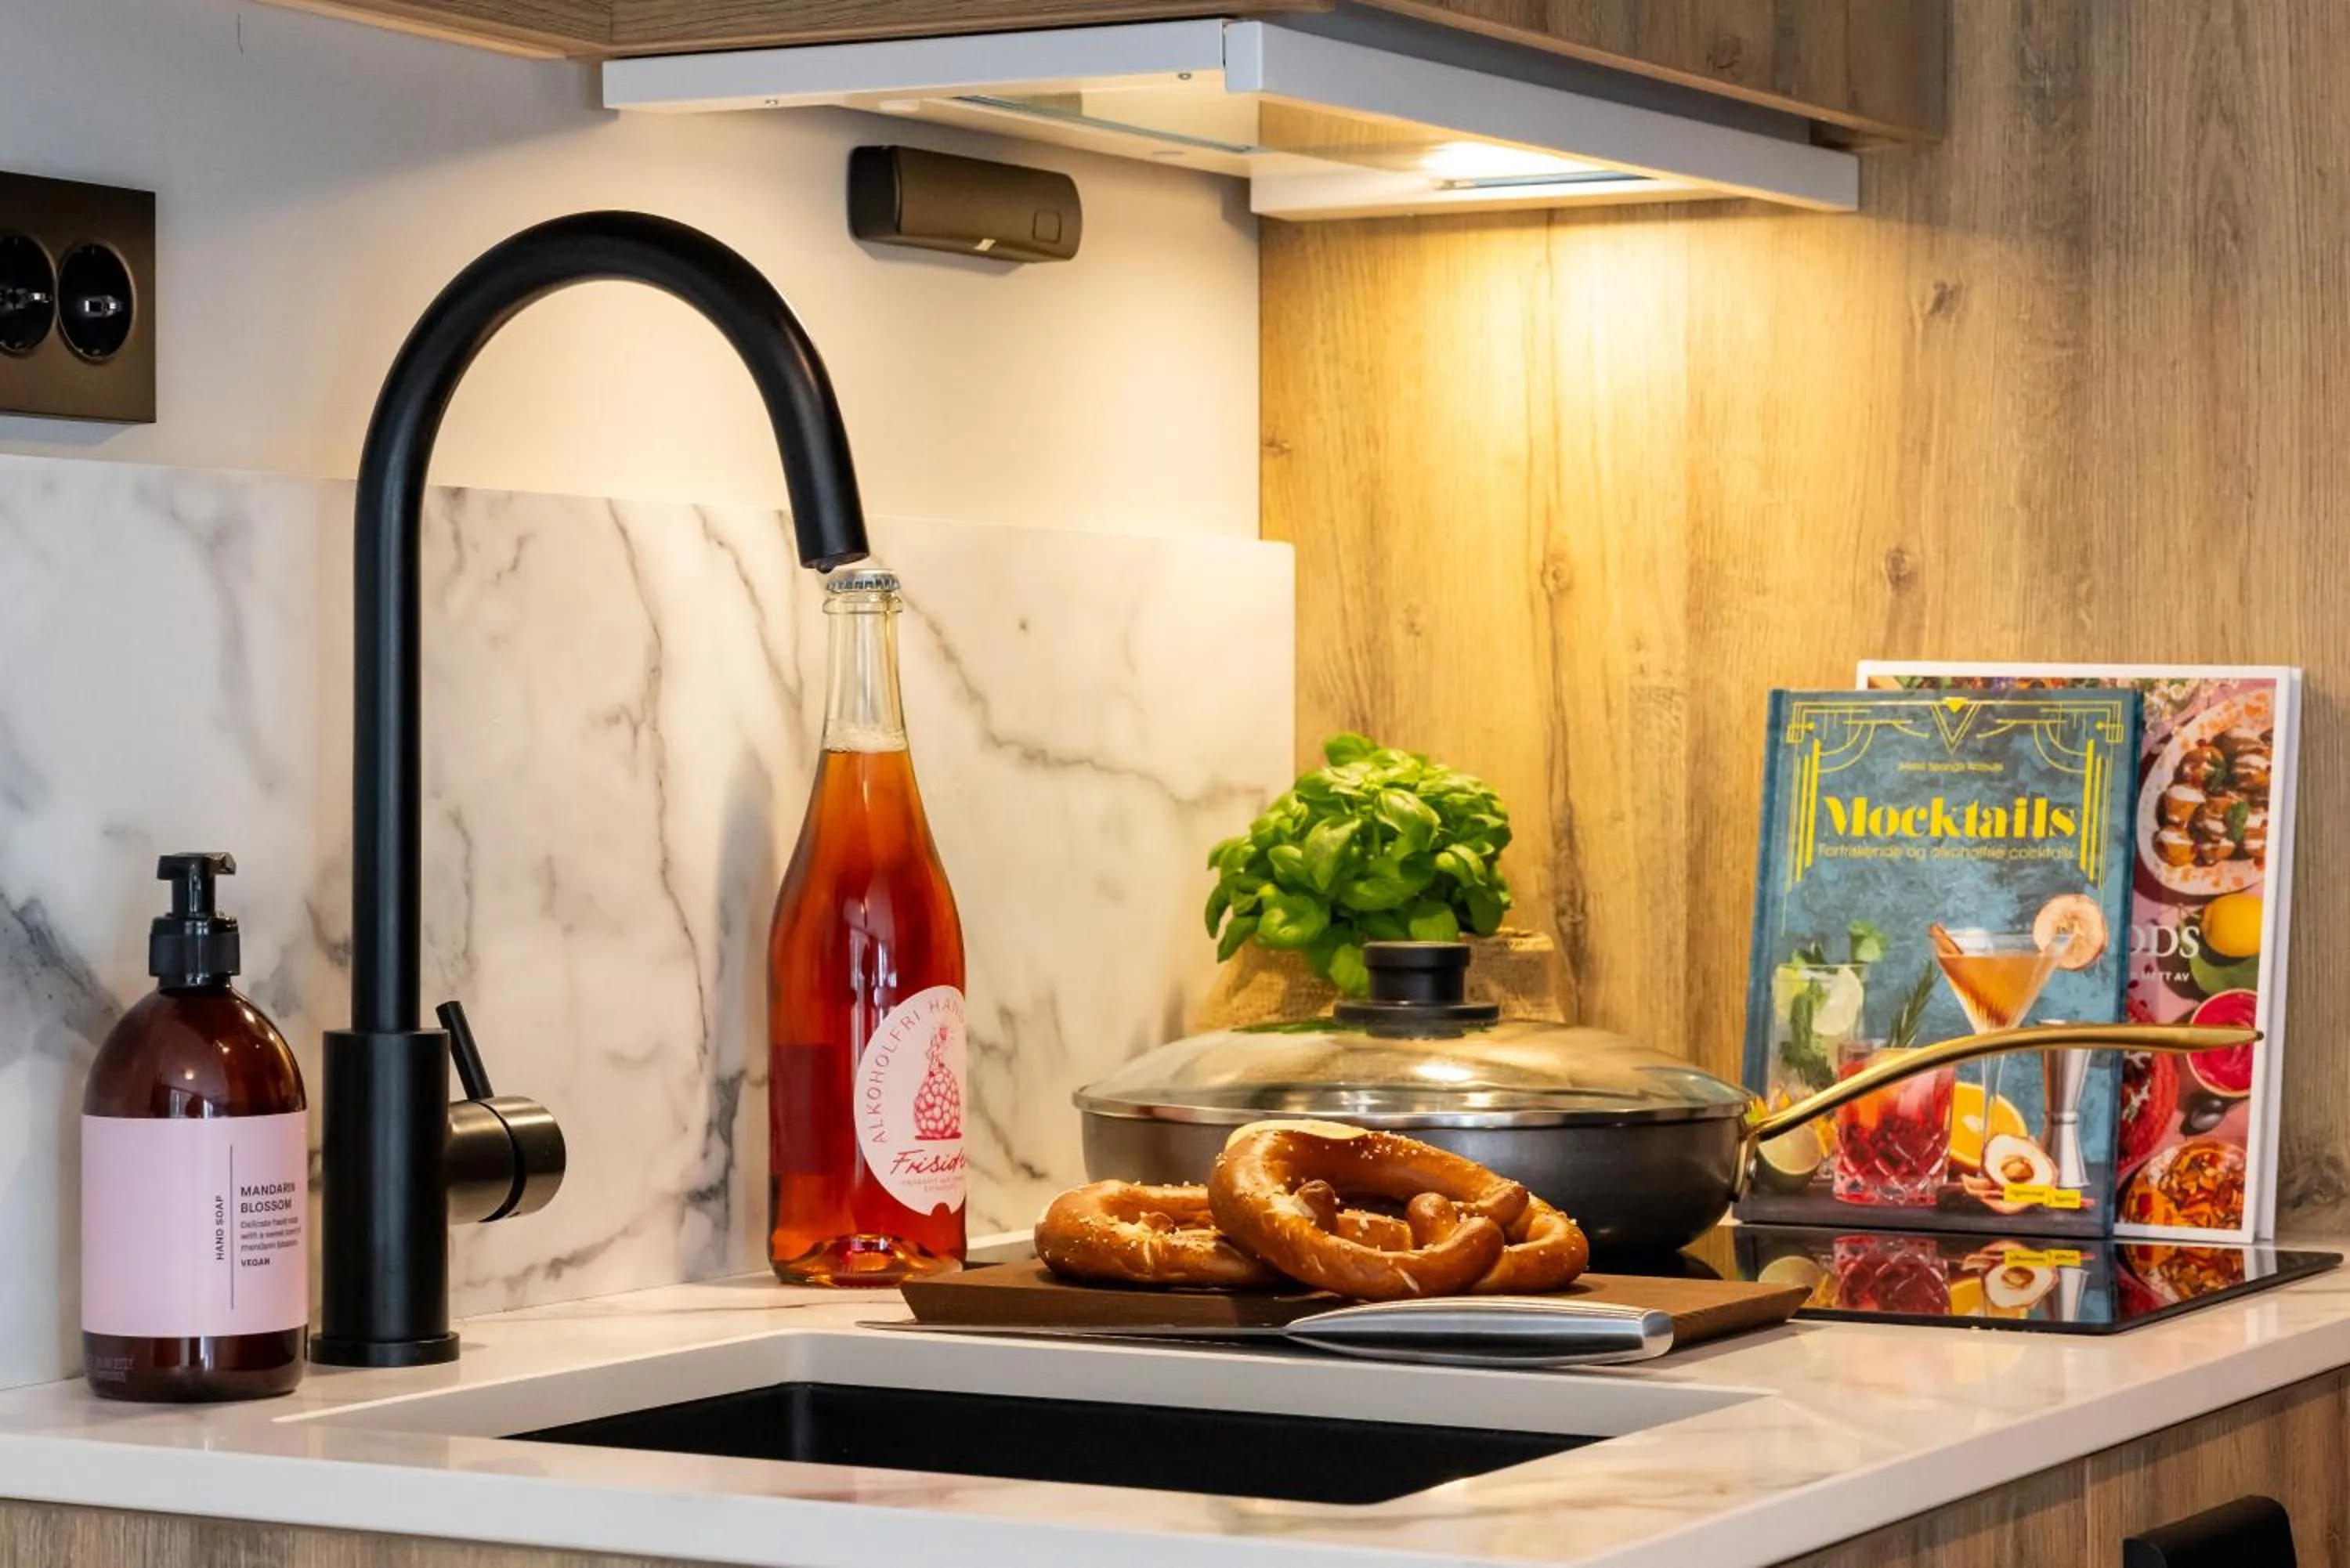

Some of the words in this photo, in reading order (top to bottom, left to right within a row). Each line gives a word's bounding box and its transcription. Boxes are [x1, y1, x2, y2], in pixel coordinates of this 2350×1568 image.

[1822, 796, 2077, 839] Mocktails
[1907, 847, 1926, 861] og
[866, 1010, 921, 1143] ALKOHOLFRI
[240, 1182, 295, 1196] MANDARIN
[215, 1195, 225, 1225] SOAP
[240, 1198, 291, 1213] BLOSSOM
[215, 1228, 225, 1260] HAND
[240, 1257, 270, 1266] VEGAN
